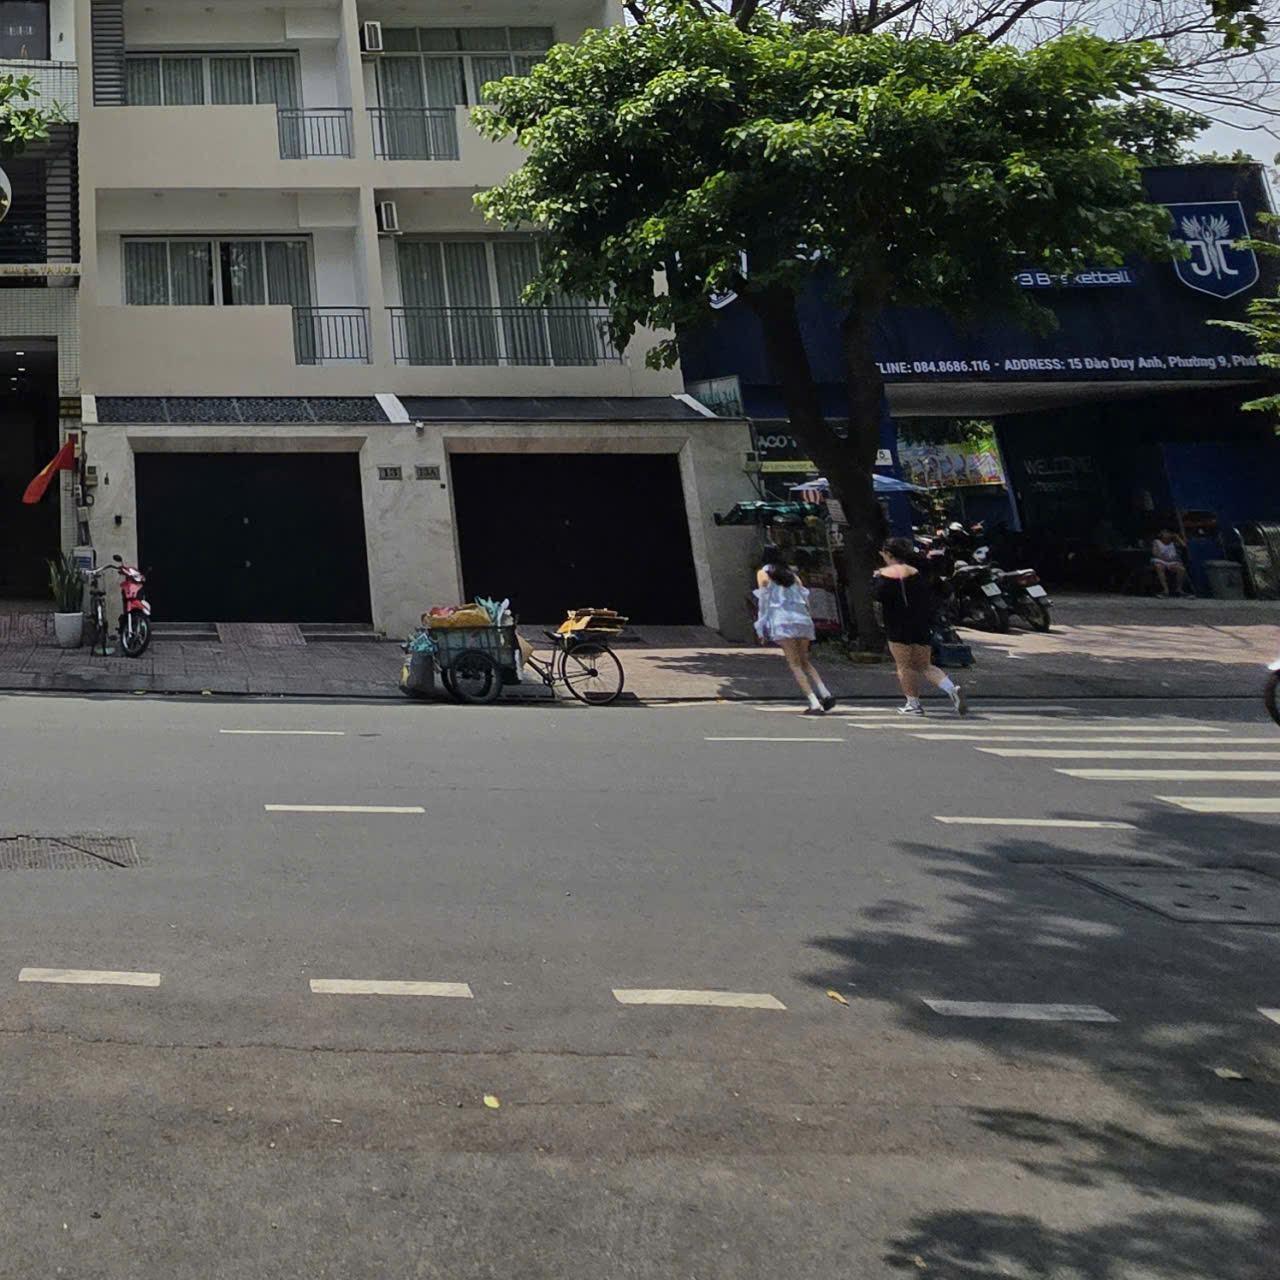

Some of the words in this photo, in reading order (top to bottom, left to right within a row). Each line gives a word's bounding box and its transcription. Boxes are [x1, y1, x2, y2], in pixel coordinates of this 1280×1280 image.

[1035, 270, 1132, 286] Bsketball
[875, 361, 912, 374] LINE:
[914, 360, 991, 373] 084.8686.116
[1004, 358, 1065, 371] ADDRESS:
[1068, 357, 1083, 369] 15
[1085, 356, 1109, 369] Đào
[1110, 357, 1135, 371] Duy
[1138, 356, 1167, 370] Anh,
[1168, 354, 1217, 370] Phường
